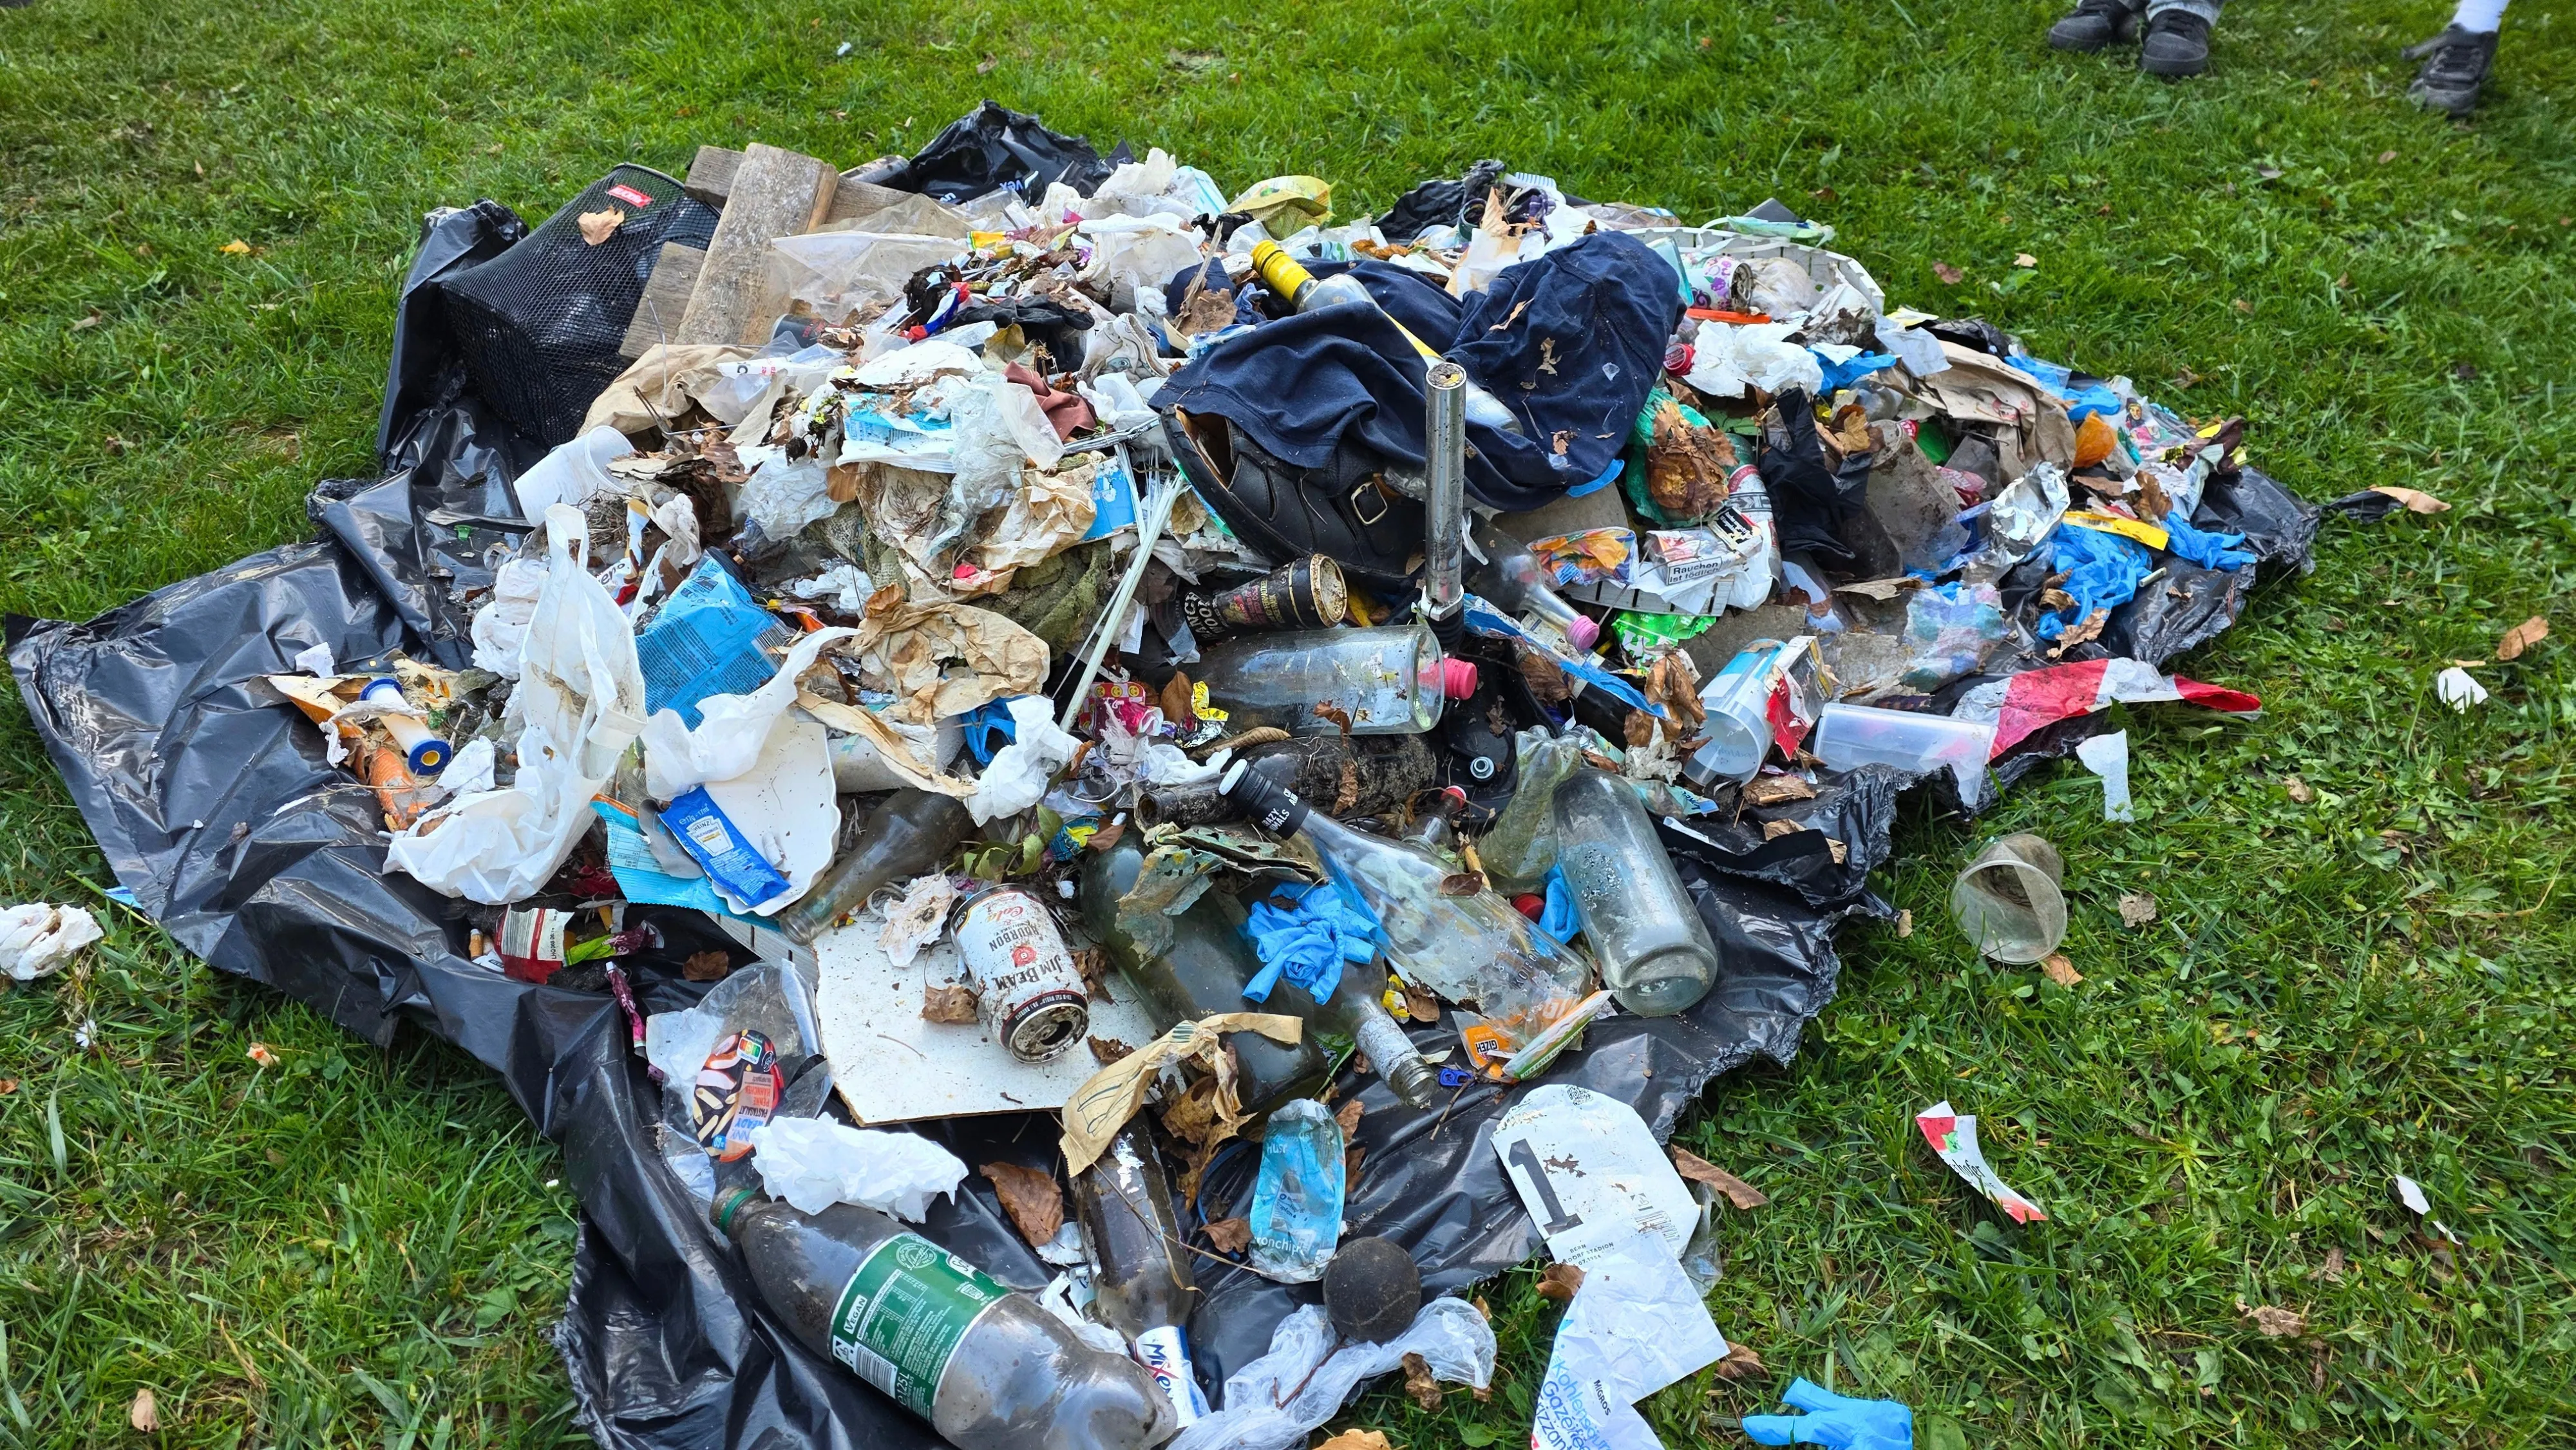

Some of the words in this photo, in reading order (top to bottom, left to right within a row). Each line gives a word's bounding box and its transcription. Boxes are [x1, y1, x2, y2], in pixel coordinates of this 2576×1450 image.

[999, 180, 1023, 191] vex
[600, 562, 626, 585] eno
[1673, 562, 1718, 575] Rauchen
[1685, 568, 1720, 579] tödlich
[694, 821, 710, 831] HEINZ
[1261, 807, 1280, 827] RAZY
[985, 906, 1024, 923] Cola
[989, 925, 1040, 952] BOURBON
[1042, 954, 1063, 975] JIM
[991, 966, 1041, 990] BEAM
[1475, 1040, 1498, 1053] GIZEH
[753, 1096, 770, 1107] PENNE
[739, 1106, 768, 1118] PASTASALAT
[1508, 1138, 1584, 1236] 1
[1569, 1243, 1586, 1254] BERN
[844, 1297, 866, 1332] VEGAN
[1551, 1359, 1612, 1450] Kohlensäur
[1593, 1379, 1612, 1416] MIGROS
